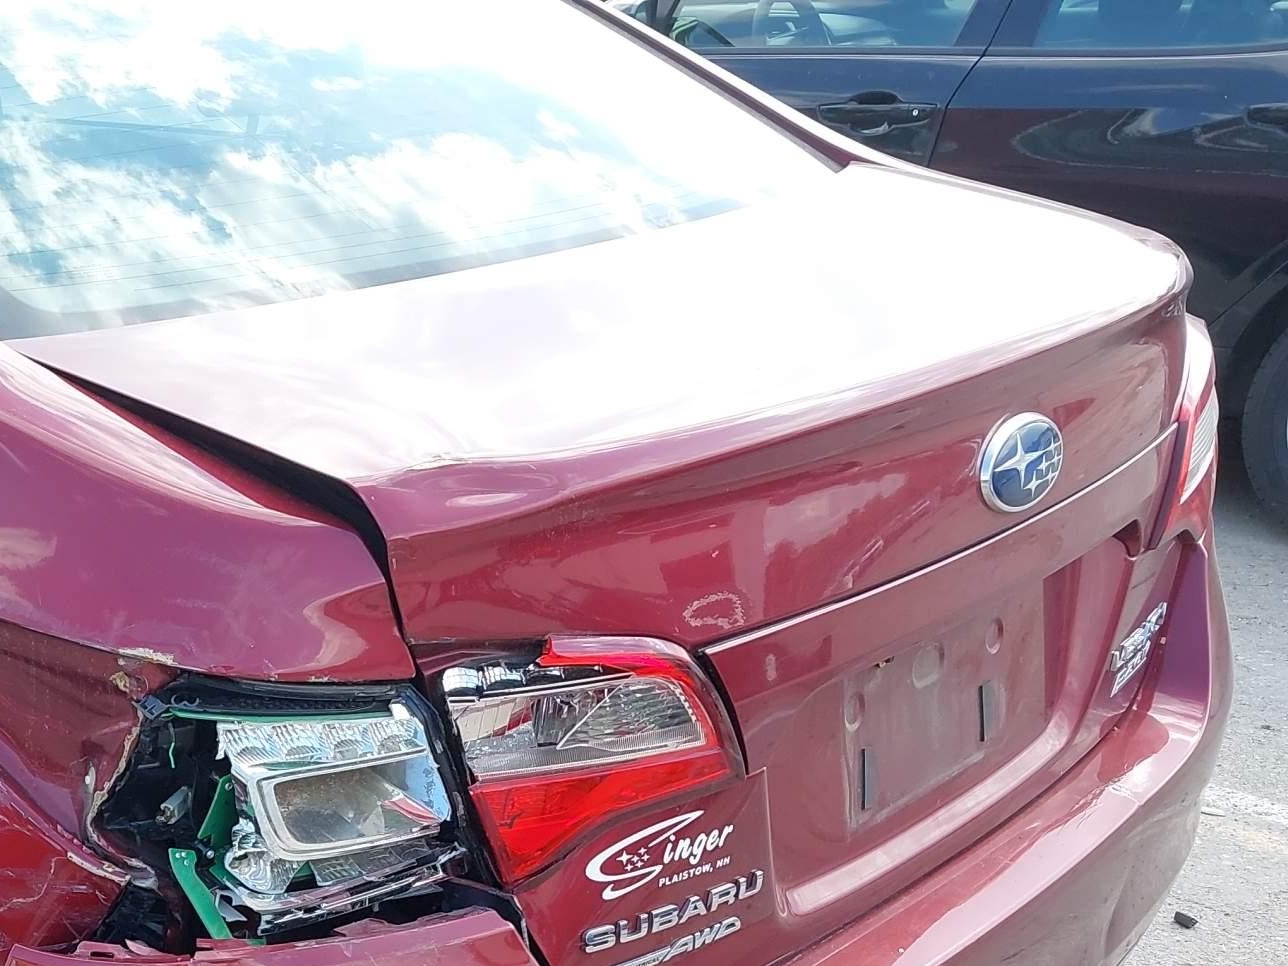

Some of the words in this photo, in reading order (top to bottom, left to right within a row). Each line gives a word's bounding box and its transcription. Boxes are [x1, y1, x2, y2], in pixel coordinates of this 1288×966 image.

[658, 862, 714, 888] PLAISTOW,
[583, 869, 764, 954] SUBARU
[662, 916, 742, 963] AWD
